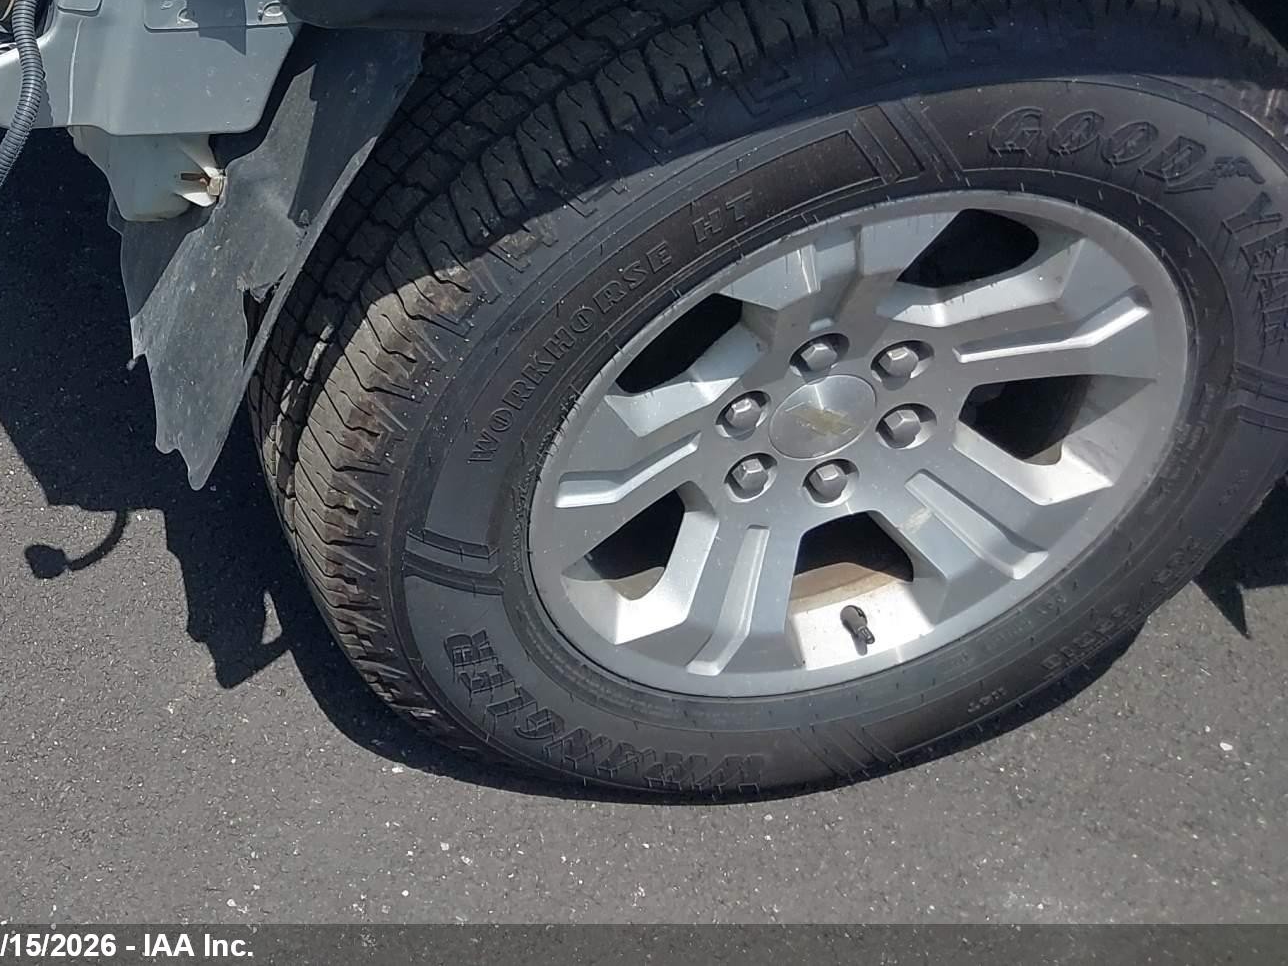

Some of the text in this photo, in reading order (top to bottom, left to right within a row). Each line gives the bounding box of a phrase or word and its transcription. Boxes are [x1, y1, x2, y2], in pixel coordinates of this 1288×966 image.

[467, 189, 753, 464] WORKHORSE HT
[443, 628, 765, 794] WRANGLER
